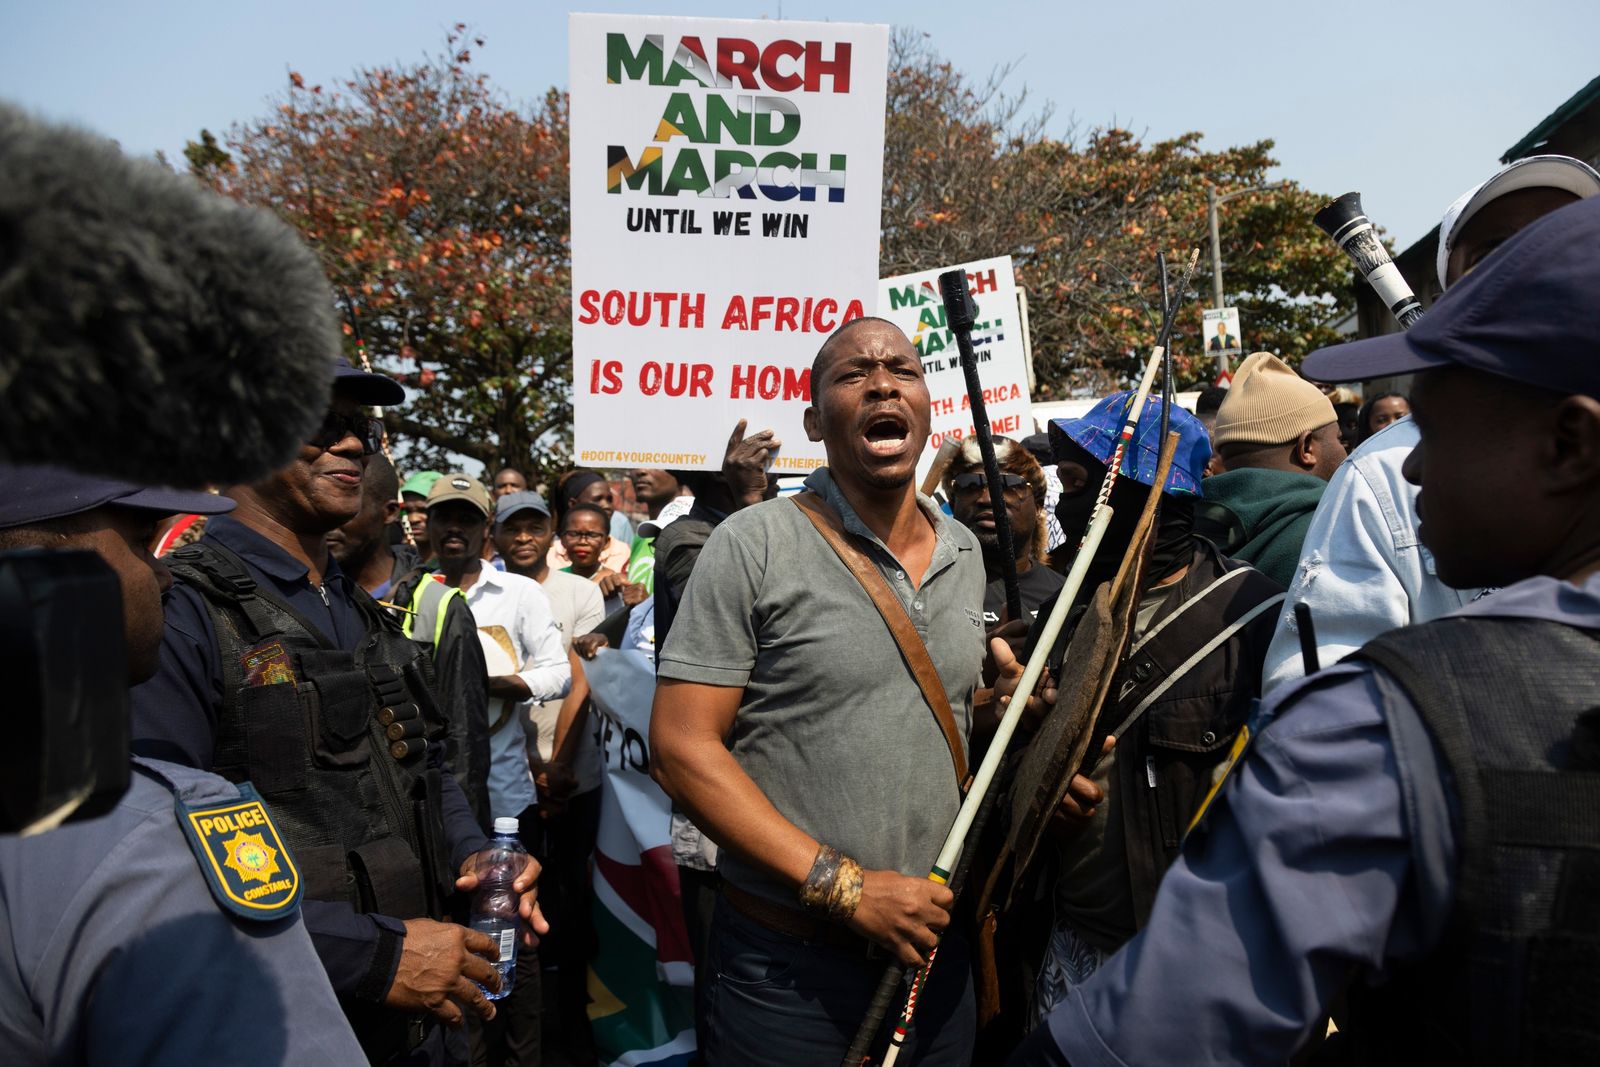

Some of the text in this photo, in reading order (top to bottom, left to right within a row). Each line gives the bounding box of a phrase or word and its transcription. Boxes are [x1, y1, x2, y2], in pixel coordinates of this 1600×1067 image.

[606, 32, 852, 94] MARCH
[652, 92, 801, 147] AND
[606, 145, 847, 203] MARCH
[626, 207, 809, 238] UNTIL WE WIN
[888, 268, 998, 311] MACH
[577, 289, 865, 334] SOUTH AFRICA
[589, 359, 812, 402] IS OUR HOM
[961, 383, 1021, 410] ARICA
[580, 450, 707, 465] #DOIT4YOURCOUNTRY
[199, 808, 266, 837] POLICE
[243, 878, 293, 902] CONSTABLE
